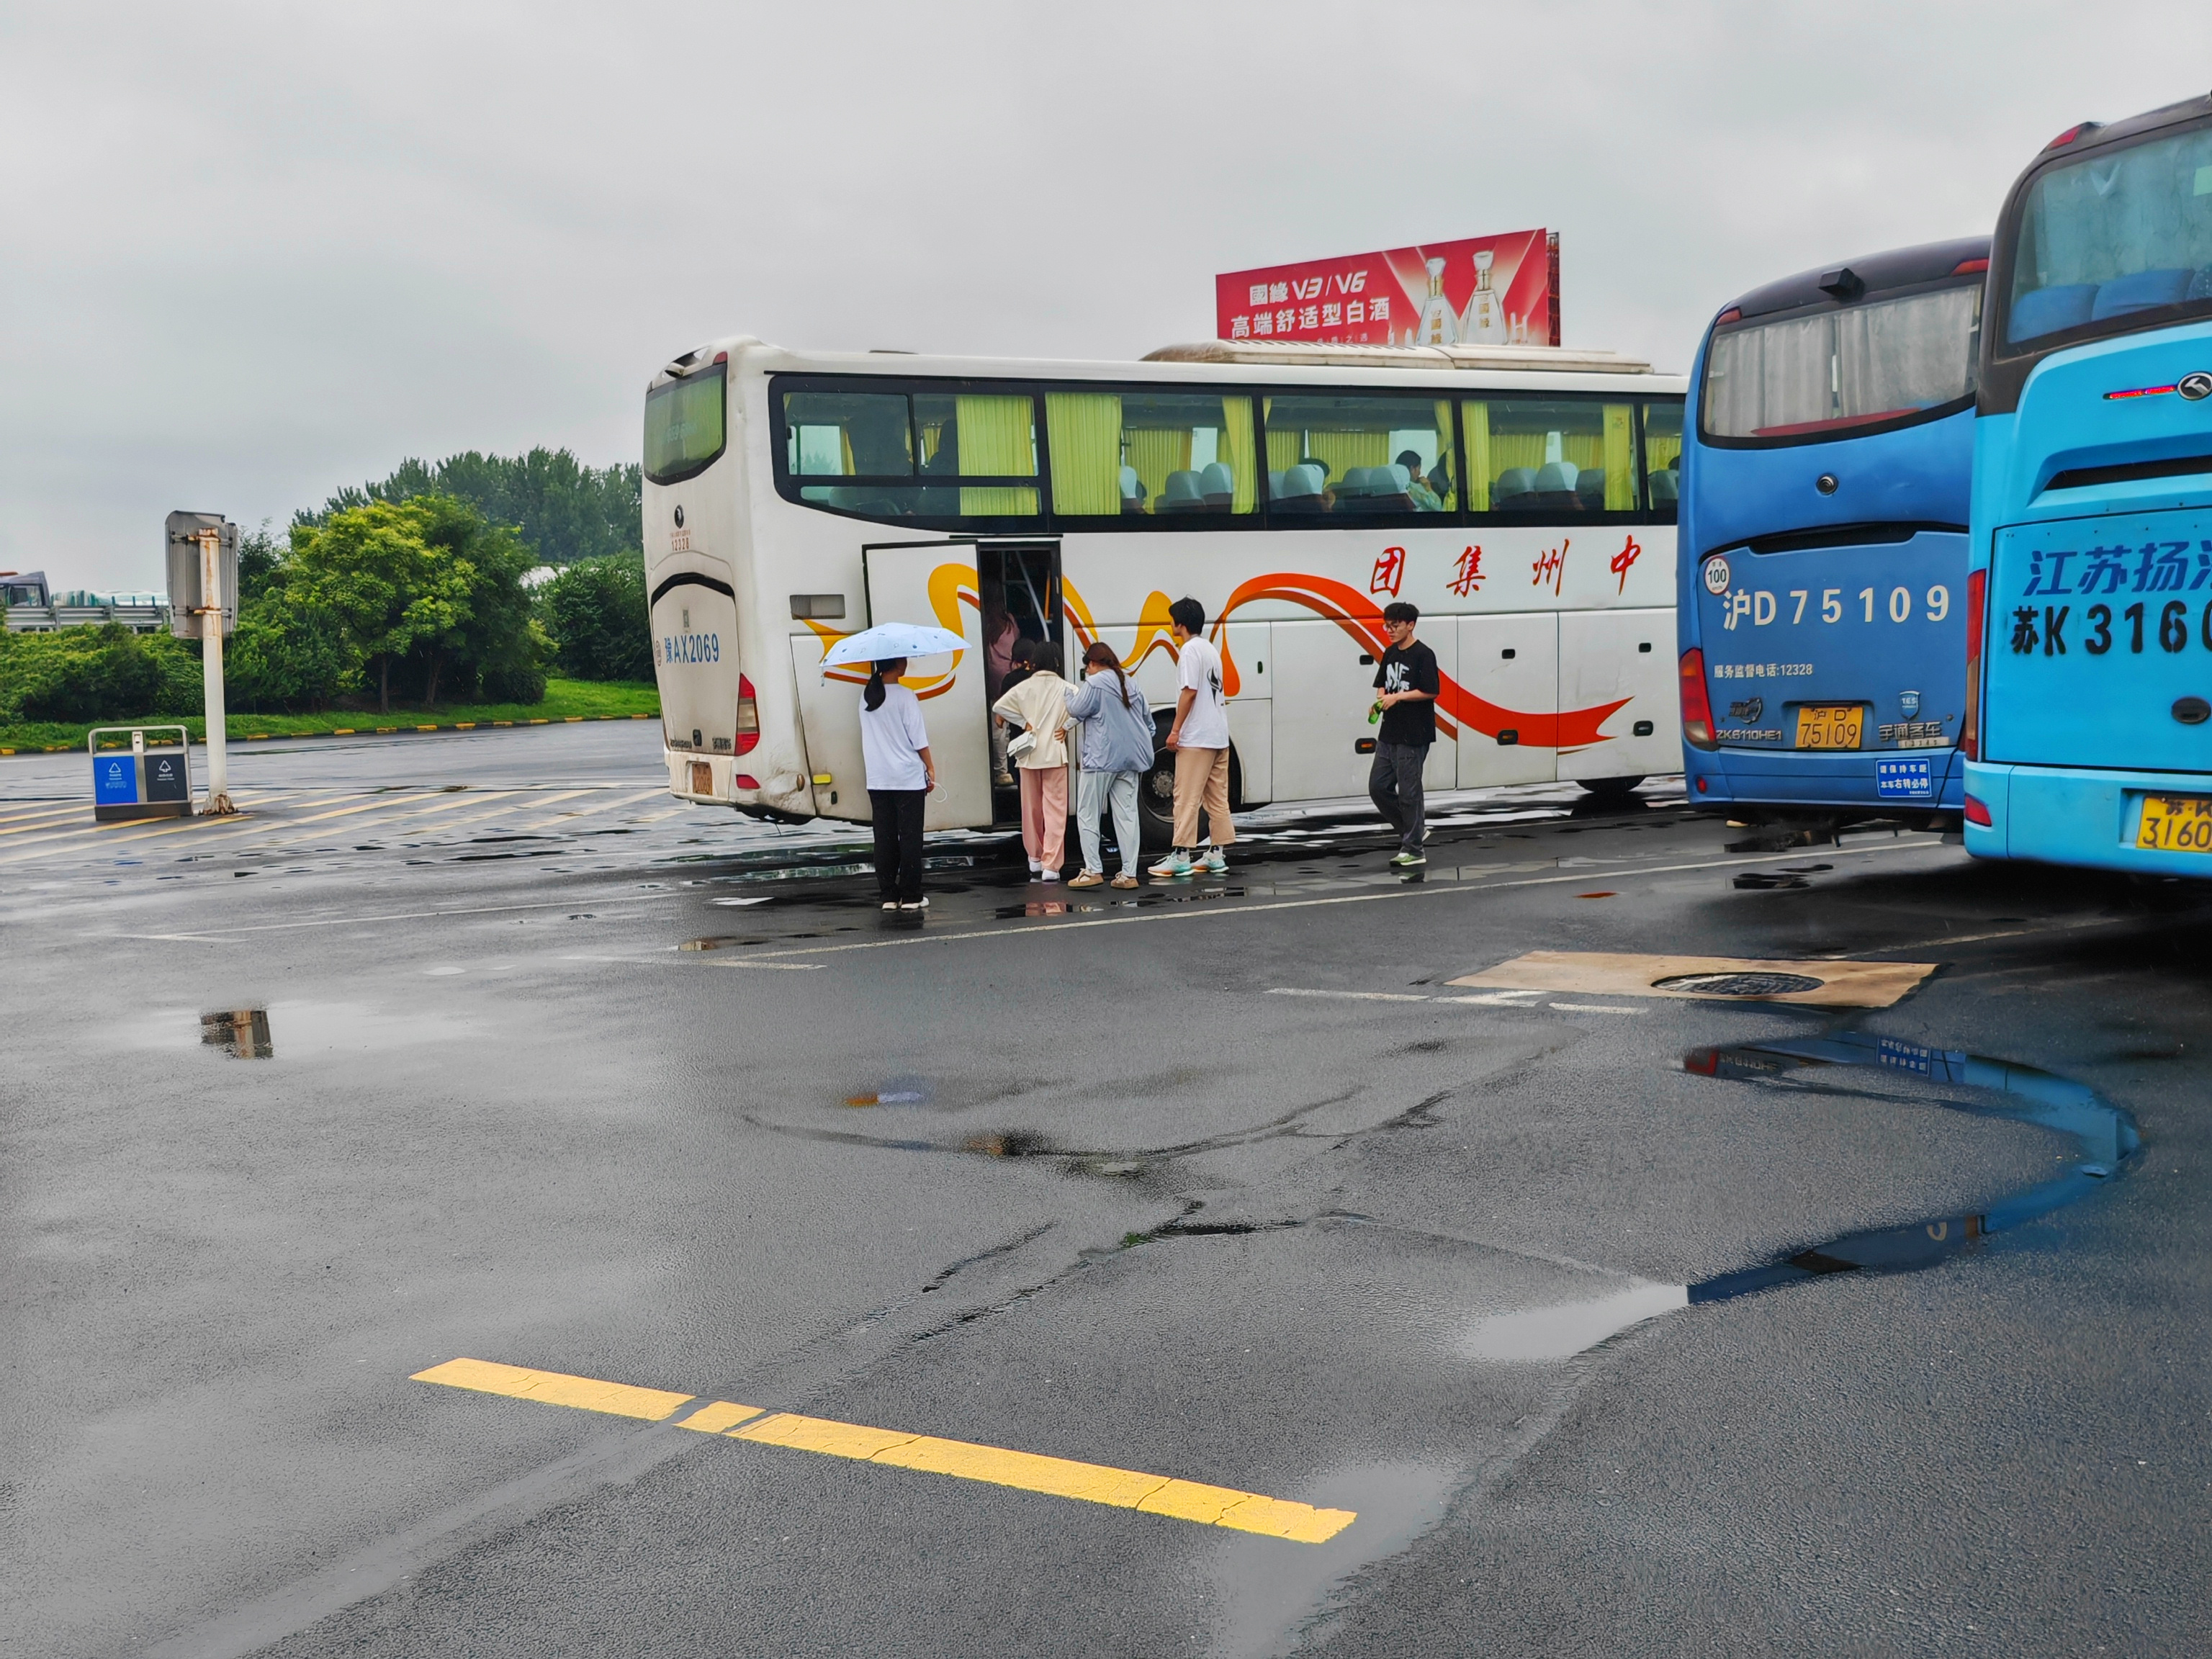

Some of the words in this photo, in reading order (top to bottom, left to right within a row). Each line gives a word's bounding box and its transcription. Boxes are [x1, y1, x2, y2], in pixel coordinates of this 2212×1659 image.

[1231, 296, 1390, 339] 高端舒适型白酒
[1708, 569, 1727, 583] 100
[1814, 709, 1846, 721] 沪D
[1801, 724, 1857, 745] 75109
[1879, 721, 1941, 742] 宇通客车
